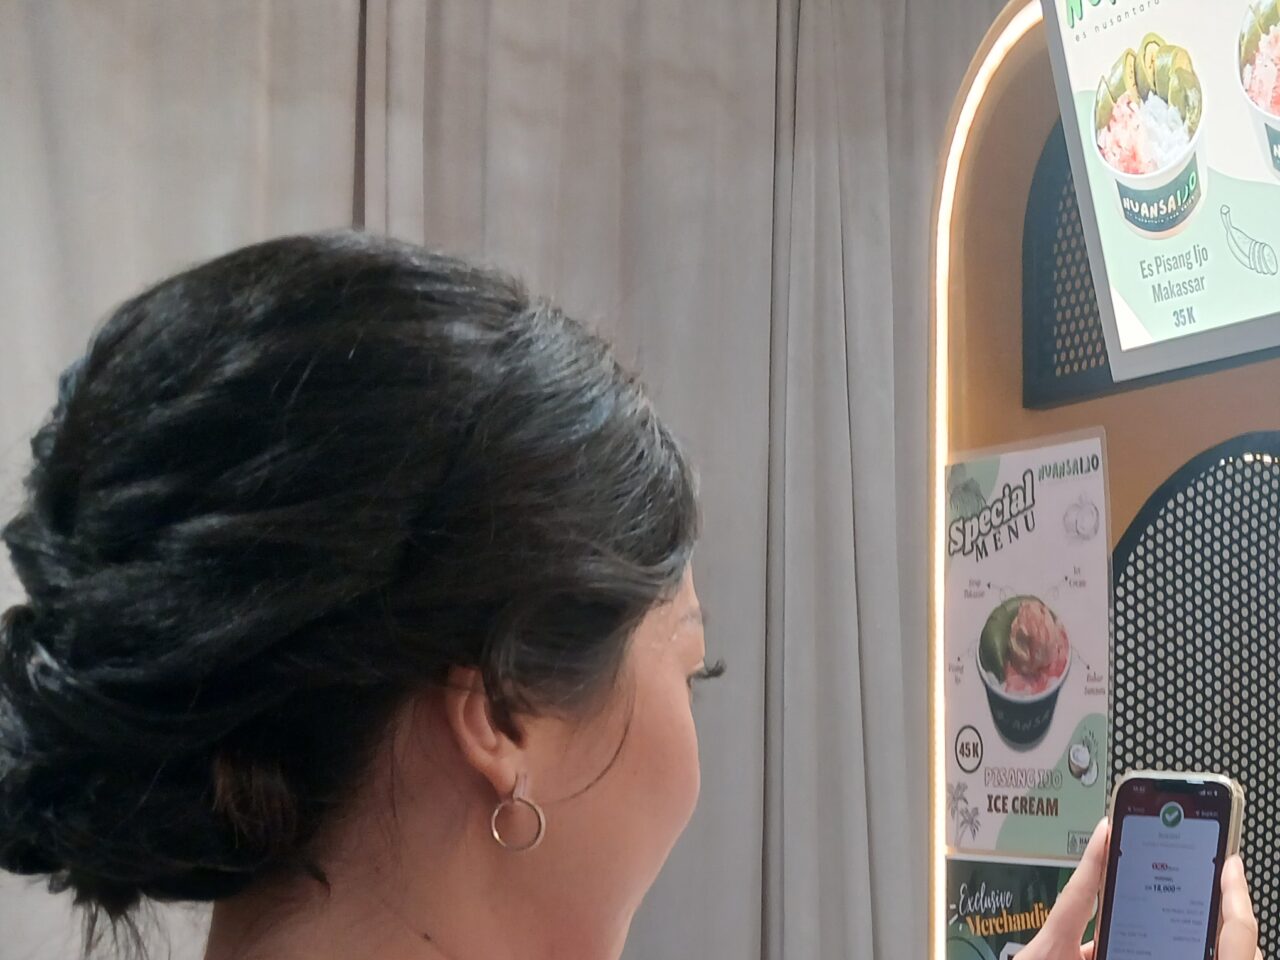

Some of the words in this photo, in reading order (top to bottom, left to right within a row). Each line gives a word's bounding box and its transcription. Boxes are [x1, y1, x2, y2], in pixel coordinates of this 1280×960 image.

[1122, 171, 1197, 219] NUANSAIJO
[1139, 260, 1154, 280] Es
[1154, 250, 1194, 275] Pisang
[1193, 244, 1209, 267] Ijo
[1151, 275, 1206, 303] Makassar
[1172, 308, 1187, 328] 35
[948, 469, 1036, 557] Special
[974, 510, 1036, 563] MENU
[958, 741, 971, 758] 45
[984, 766, 1036, 789] PISANG
[986, 794, 1009, 815] ICE
[1011, 795, 1059, 817] CREAM
[959, 882, 1013, 915] Exclusive
